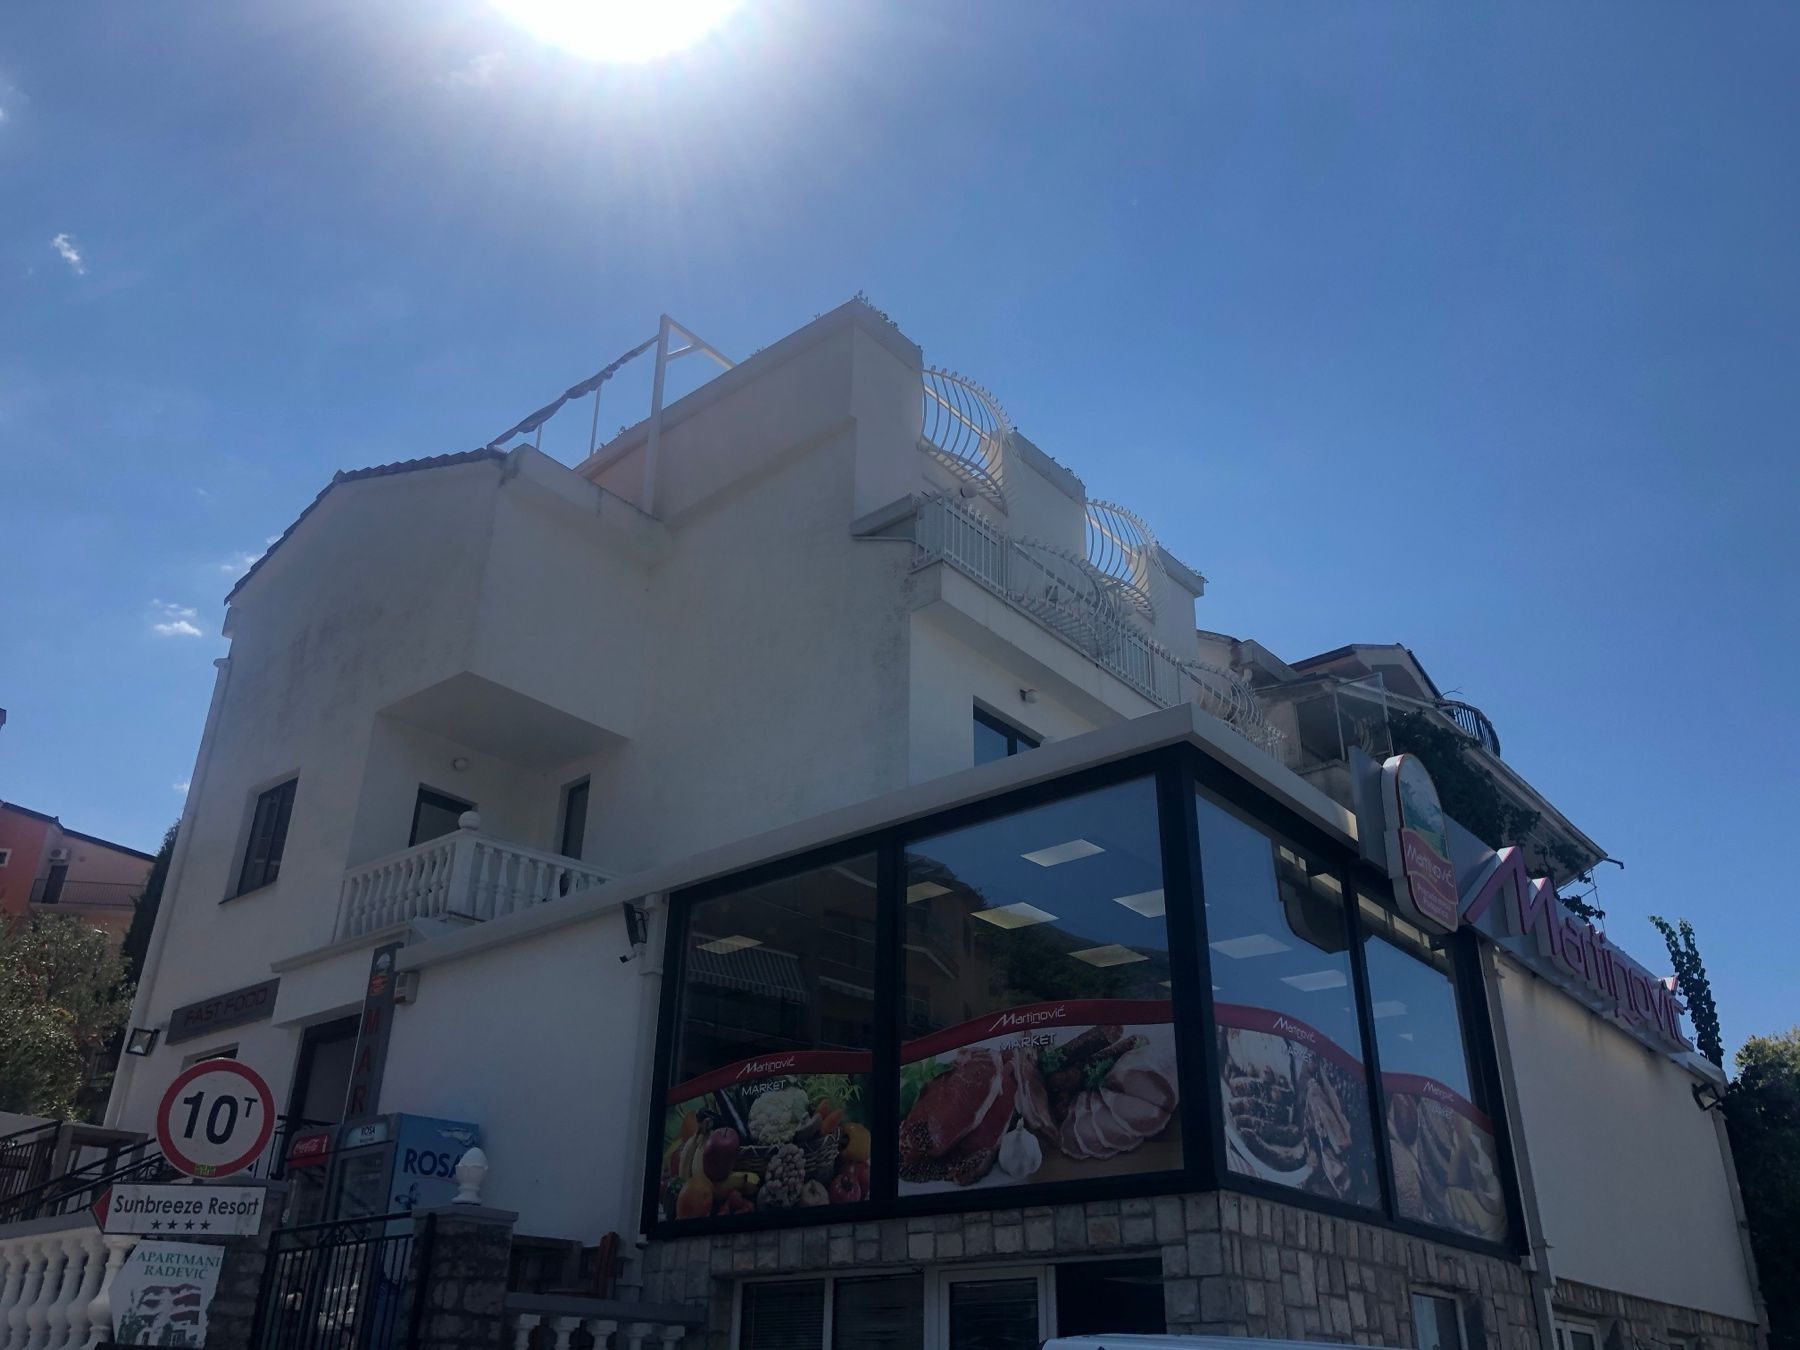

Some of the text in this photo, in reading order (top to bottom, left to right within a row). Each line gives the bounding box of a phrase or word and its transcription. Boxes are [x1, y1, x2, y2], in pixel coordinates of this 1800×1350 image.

[184, 988, 268, 1027] FAST FOOD
[988, 1005, 1067, 1032] Martinović
[1000, 1033, 1056, 1050] MARKET
[736, 1056, 796, 1079] Martinović
[741, 1080, 788, 1097] MARKET
[114, 1195, 260, 1216] Sunbreeze Resort
[136, 1251, 221, 1268] APARTMANI
